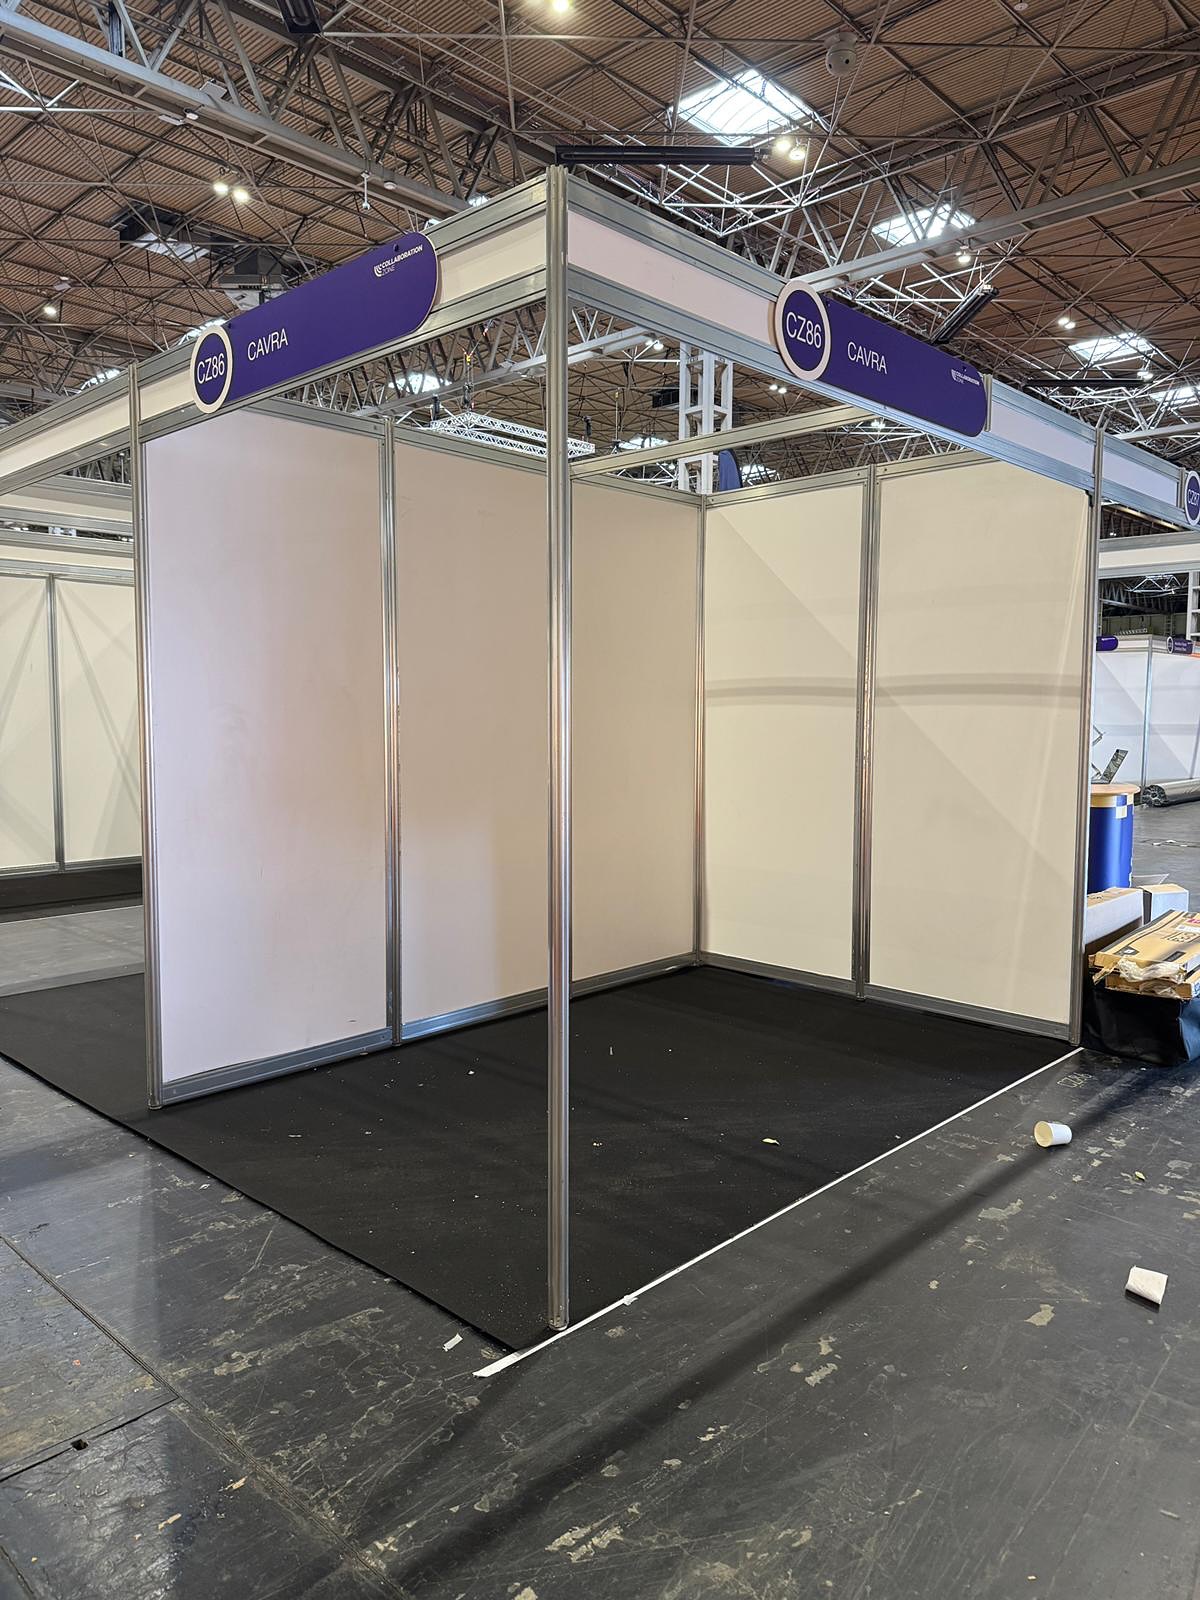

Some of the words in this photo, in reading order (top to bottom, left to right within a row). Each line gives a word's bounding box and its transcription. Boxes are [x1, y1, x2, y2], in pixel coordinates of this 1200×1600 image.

[381, 244, 423, 269] COLLABORATION
[382, 264, 396, 276] ZONE
[247, 328, 288, 361] CAVRA
[786, 311, 822, 349] CZ86
[197, 353, 225, 384] CZ86
[847, 341, 887, 374] CAVRA
